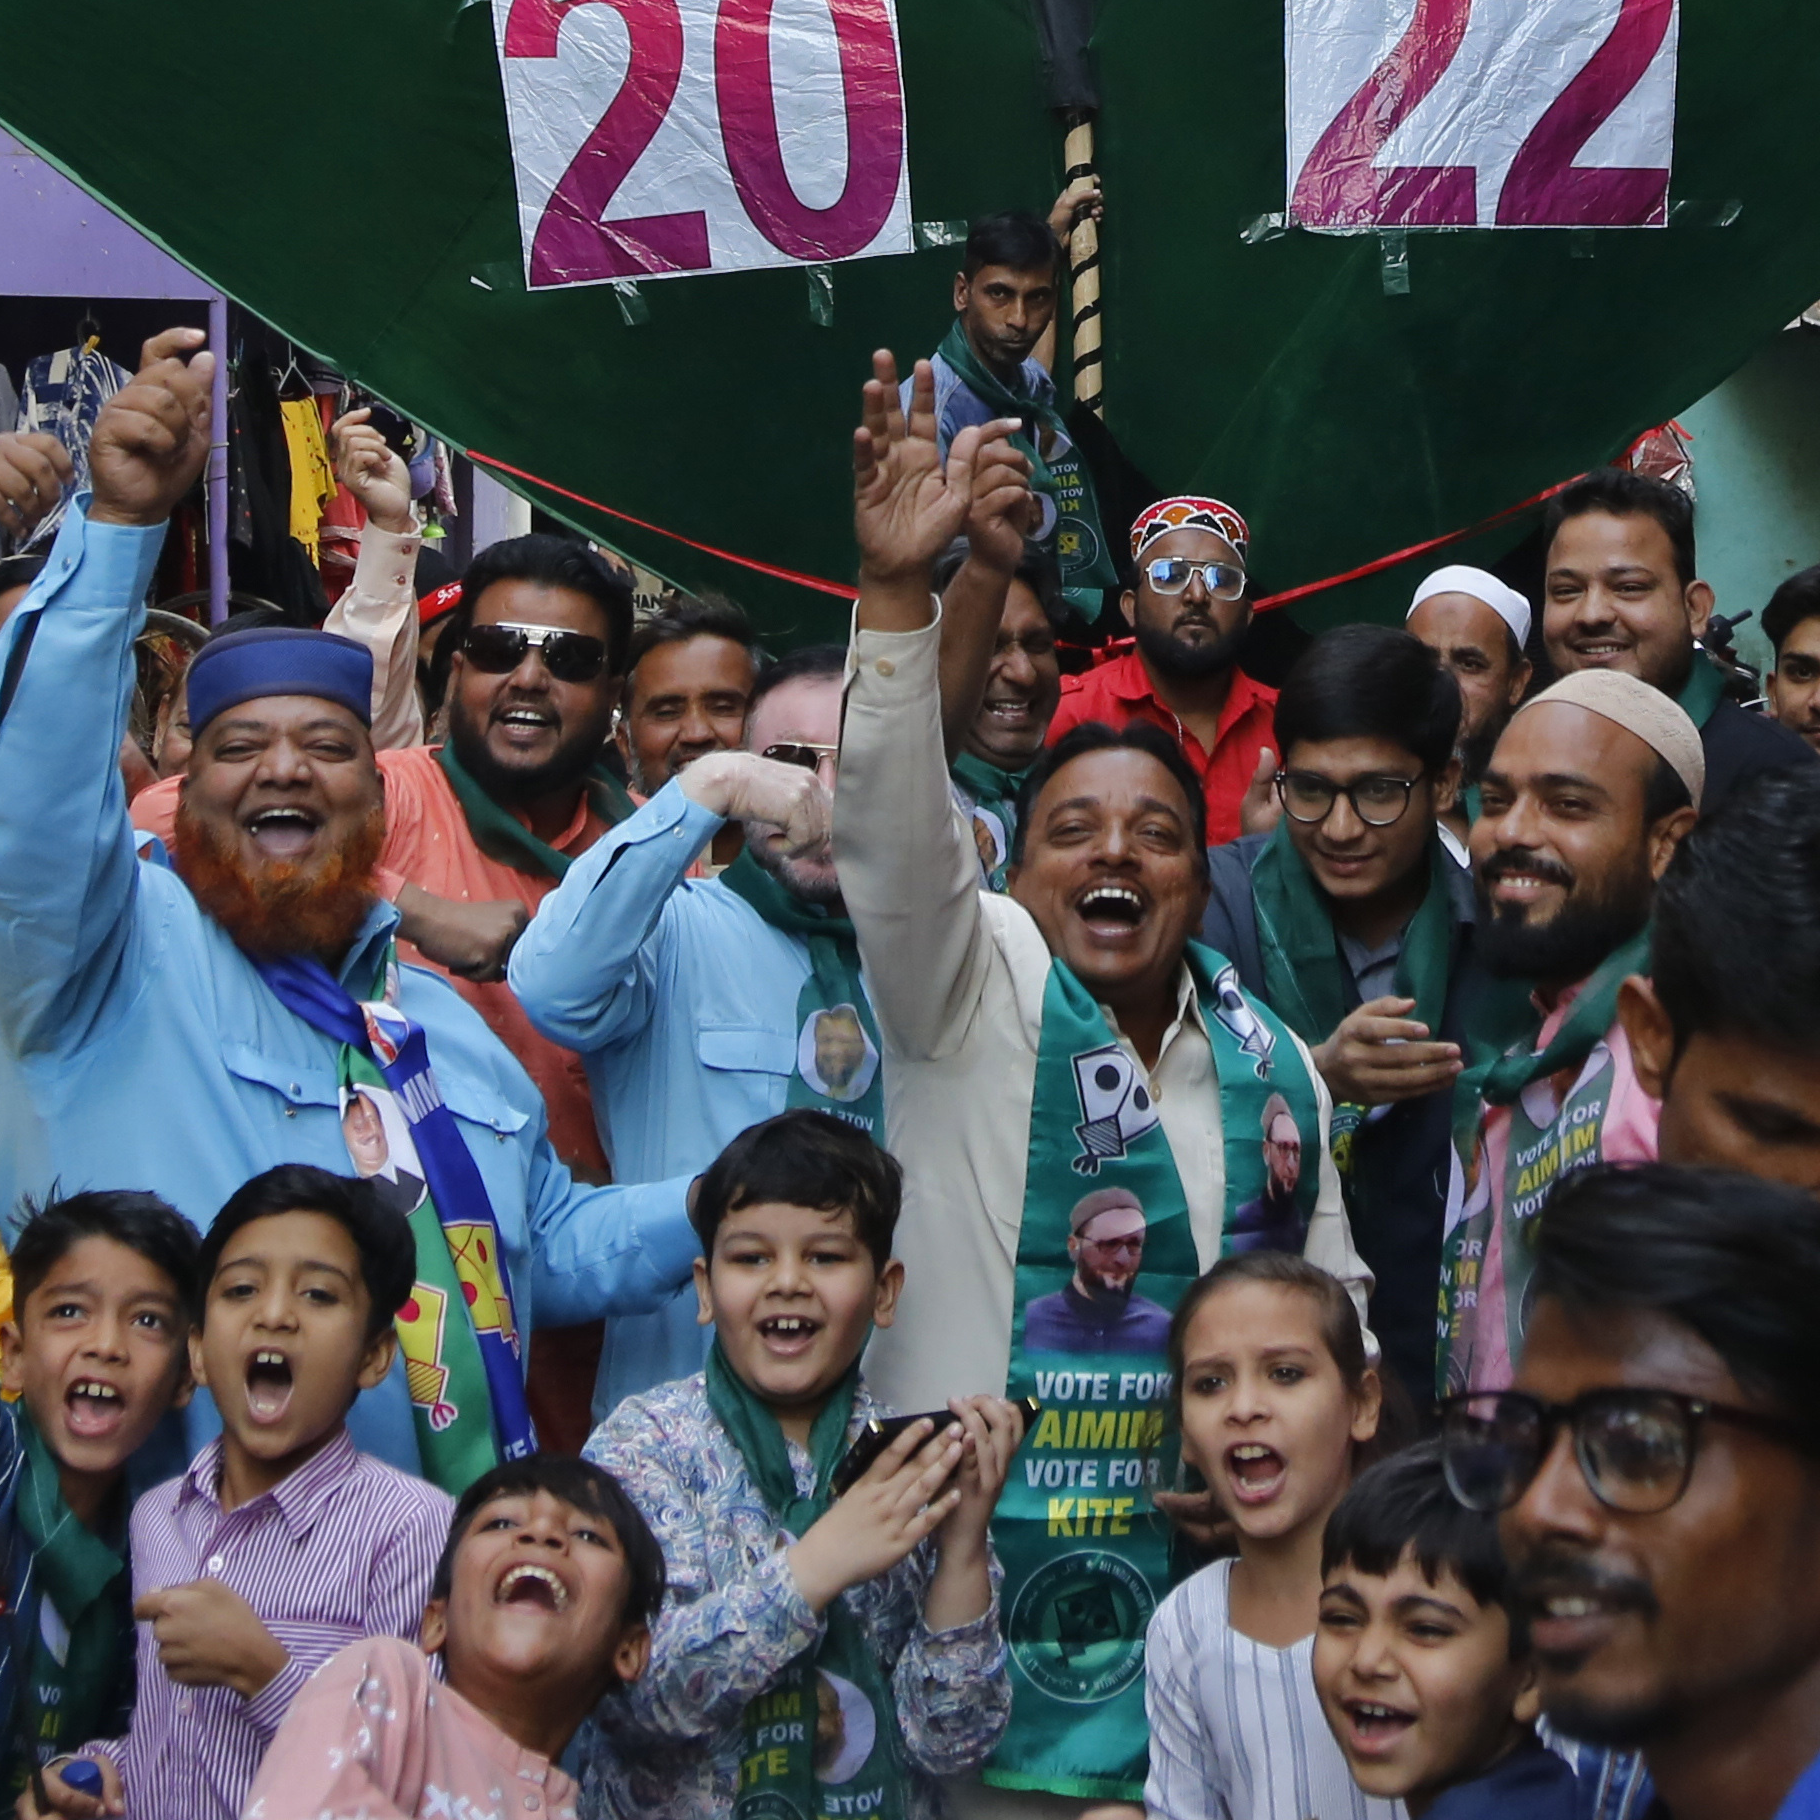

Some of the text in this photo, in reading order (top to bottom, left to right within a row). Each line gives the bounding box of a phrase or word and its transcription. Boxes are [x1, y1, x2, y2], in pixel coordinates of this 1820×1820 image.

[1515, 1130, 1552, 1167] VOTE
[1035, 1371, 1173, 1401] VOTE FOR
[1033, 1409, 1164, 1449] AIMIM
[1024, 1458, 1161, 1488] VOTE FOR
[1047, 1496, 1134, 1538] KITE
